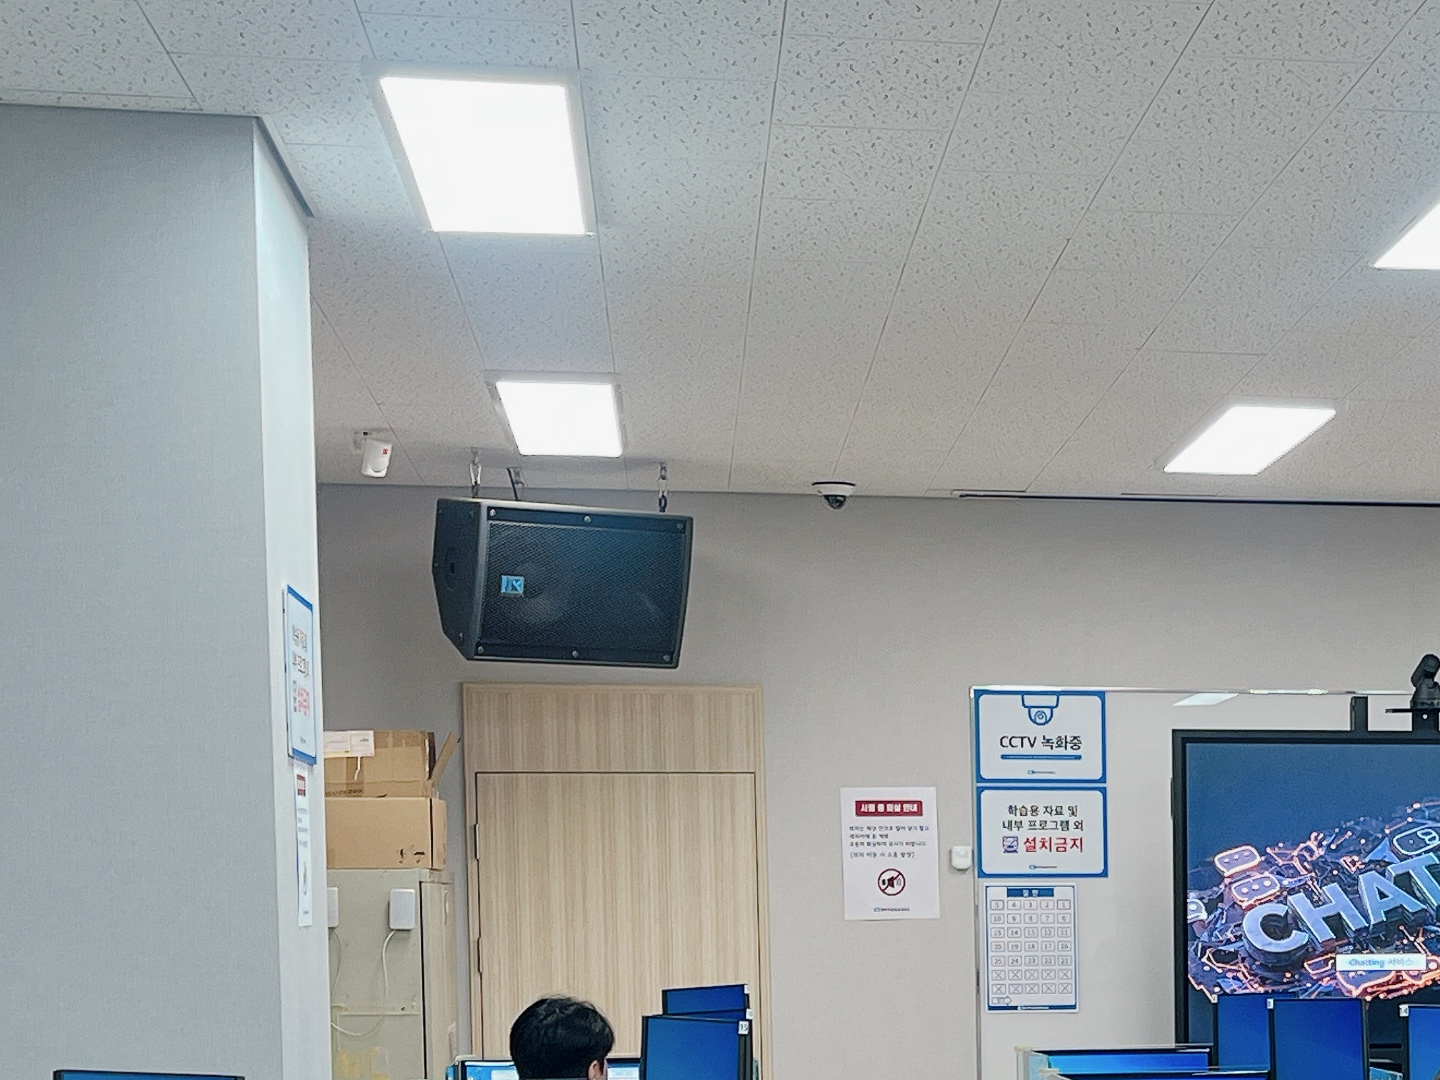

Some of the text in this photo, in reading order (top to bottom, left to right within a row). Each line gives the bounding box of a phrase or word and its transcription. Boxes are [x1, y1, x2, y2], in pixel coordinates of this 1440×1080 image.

[999, 735, 1082, 751] CCTV 녹화중
[1008, 805, 1040, 816] 학습용
[1043, 805, 1065, 816] 자료
[1002, 820, 1024, 831] 내부
[1027, 820, 1070, 831] 프로그램
[1024, 836, 1083, 853] 설치금지
[1349, 959, 1385, 968] Chatting
